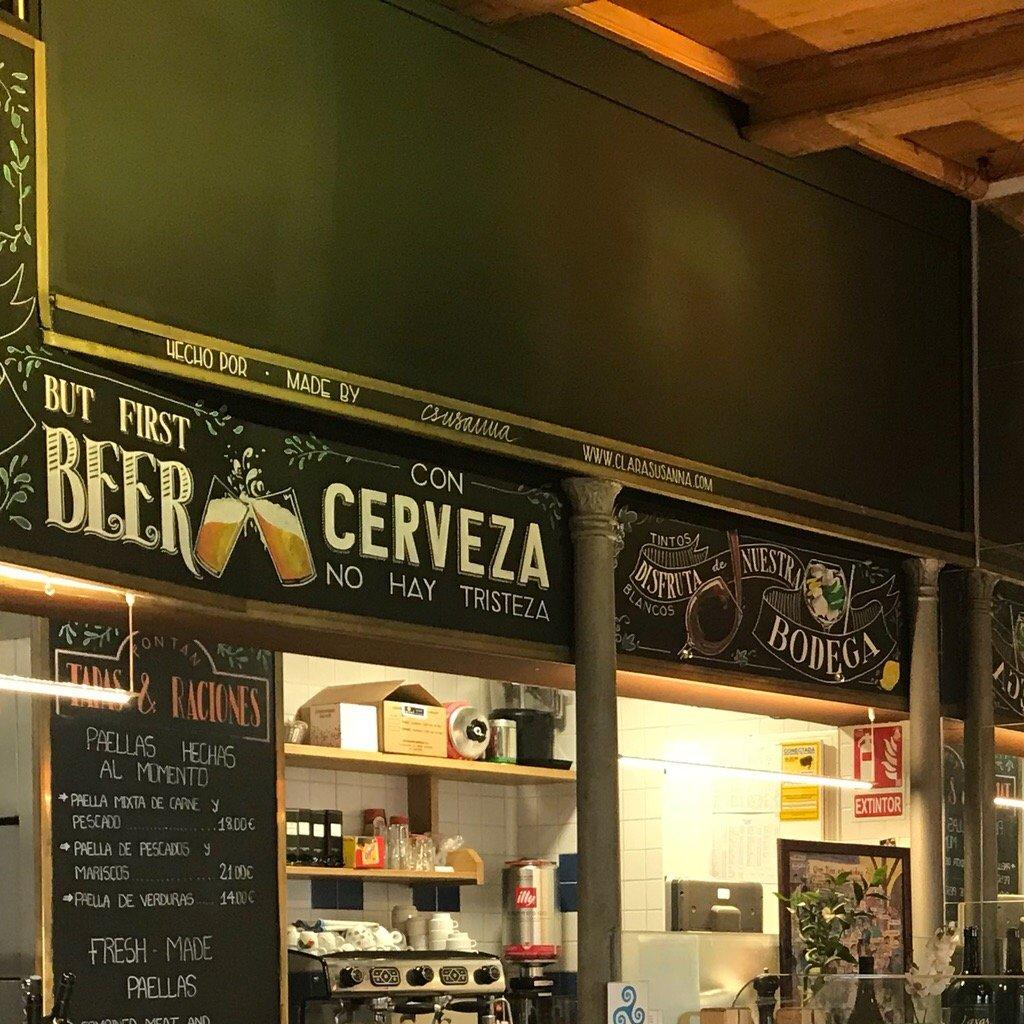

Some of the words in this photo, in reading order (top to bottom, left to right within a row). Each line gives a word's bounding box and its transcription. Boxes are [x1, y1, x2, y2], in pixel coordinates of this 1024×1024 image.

[166, 339, 214, 369] HECHO
[219, 351, 248, 377] POR
[287, 369, 331, 399] MADE
[339, 382, 360, 404] BY
[43, 373, 96, 424] BUT
[118, 396, 192, 452] FIRST
[410, 462, 465, 495] CON
[42, 420, 205, 581] BEER
[322, 481, 552, 592] CERVEZA
[649, 532, 692, 547] TINTOS
[634, 560, 703, 600] DISFRUTA
[711, 559, 728, 572] de
[741, 548, 802, 588] NUESTRA
[326, 561, 364, 589] NO
[389, 574, 438, 602] HAY
[463, 584, 551, 623] TRISTEZA
[622, 583, 676, 618] BLANCOS
[767, 614, 881, 676] BODEGA
[137, 672, 157, 715] &
[171, 675, 261, 728] RACIONES
[86, 726, 157, 758] PAELLAS
[182, 740, 236, 769] HECHAS
[100, 760, 123, 781] AL
[137, 761, 210, 788] MOMENTO
[71, 793, 108, 808] PAELLA
[114, 794, 146, 810] MIXTA
[151, 796, 165, 810] DE
[169, 797, 200, 812] CARNE
[855, 796, 902, 815] EXTINTOR
[72, 814, 122, 830] PESCADO
[74, 840, 113, 856] PAELLA
[118, 842, 133, 856] DE
[140, 841, 190, 856] PESCADOS
[74, 864, 131, 881] MARISCOS
[74, 891, 111, 909] PAELLA
[118, 893, 135, 908] DE
[140, 893, 195, 907] VERDURAS
[516, 889, 536, 906] illy
[88, 937, 148, 966] FRESH
[166, 935, 214, 962] MADE
[127, 974, 198, 1000] PAELLAS
